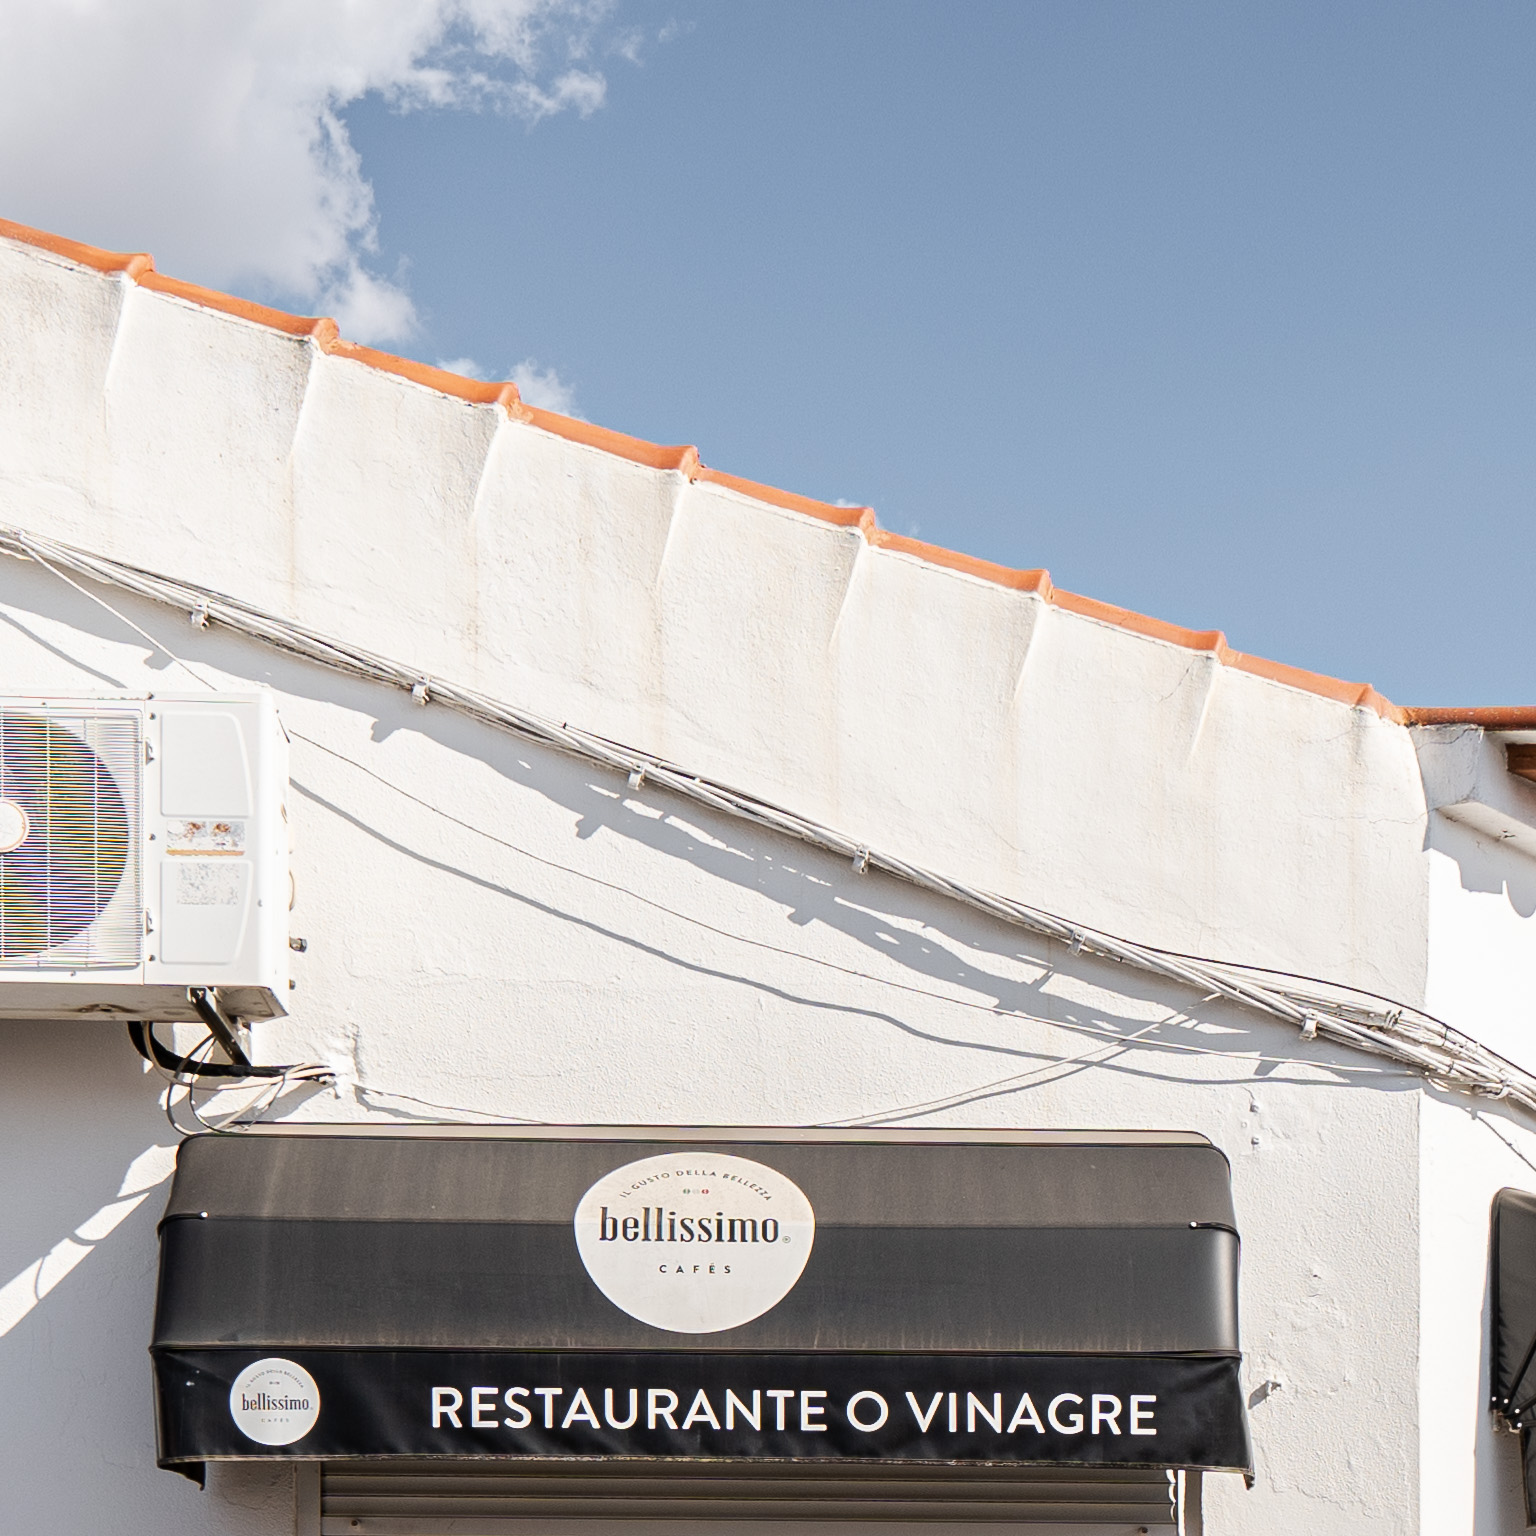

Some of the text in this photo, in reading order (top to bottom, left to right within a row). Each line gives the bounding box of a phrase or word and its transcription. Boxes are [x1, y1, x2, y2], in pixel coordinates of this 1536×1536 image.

[631, 1172, 670, 1190] GUSTO
[675, 1169, 717, 1177] DELLA
[722, 1173, 772, 1201] BELLEZZA
[599, 1206, 779, 1243] bellissimo
[659, 1263, 732, 1274] CAFÉS
[242, 1392, 310, 1411] bellissimo
[431, 1386, 1158, 1435] RESTAURANTE O VINAGRE
